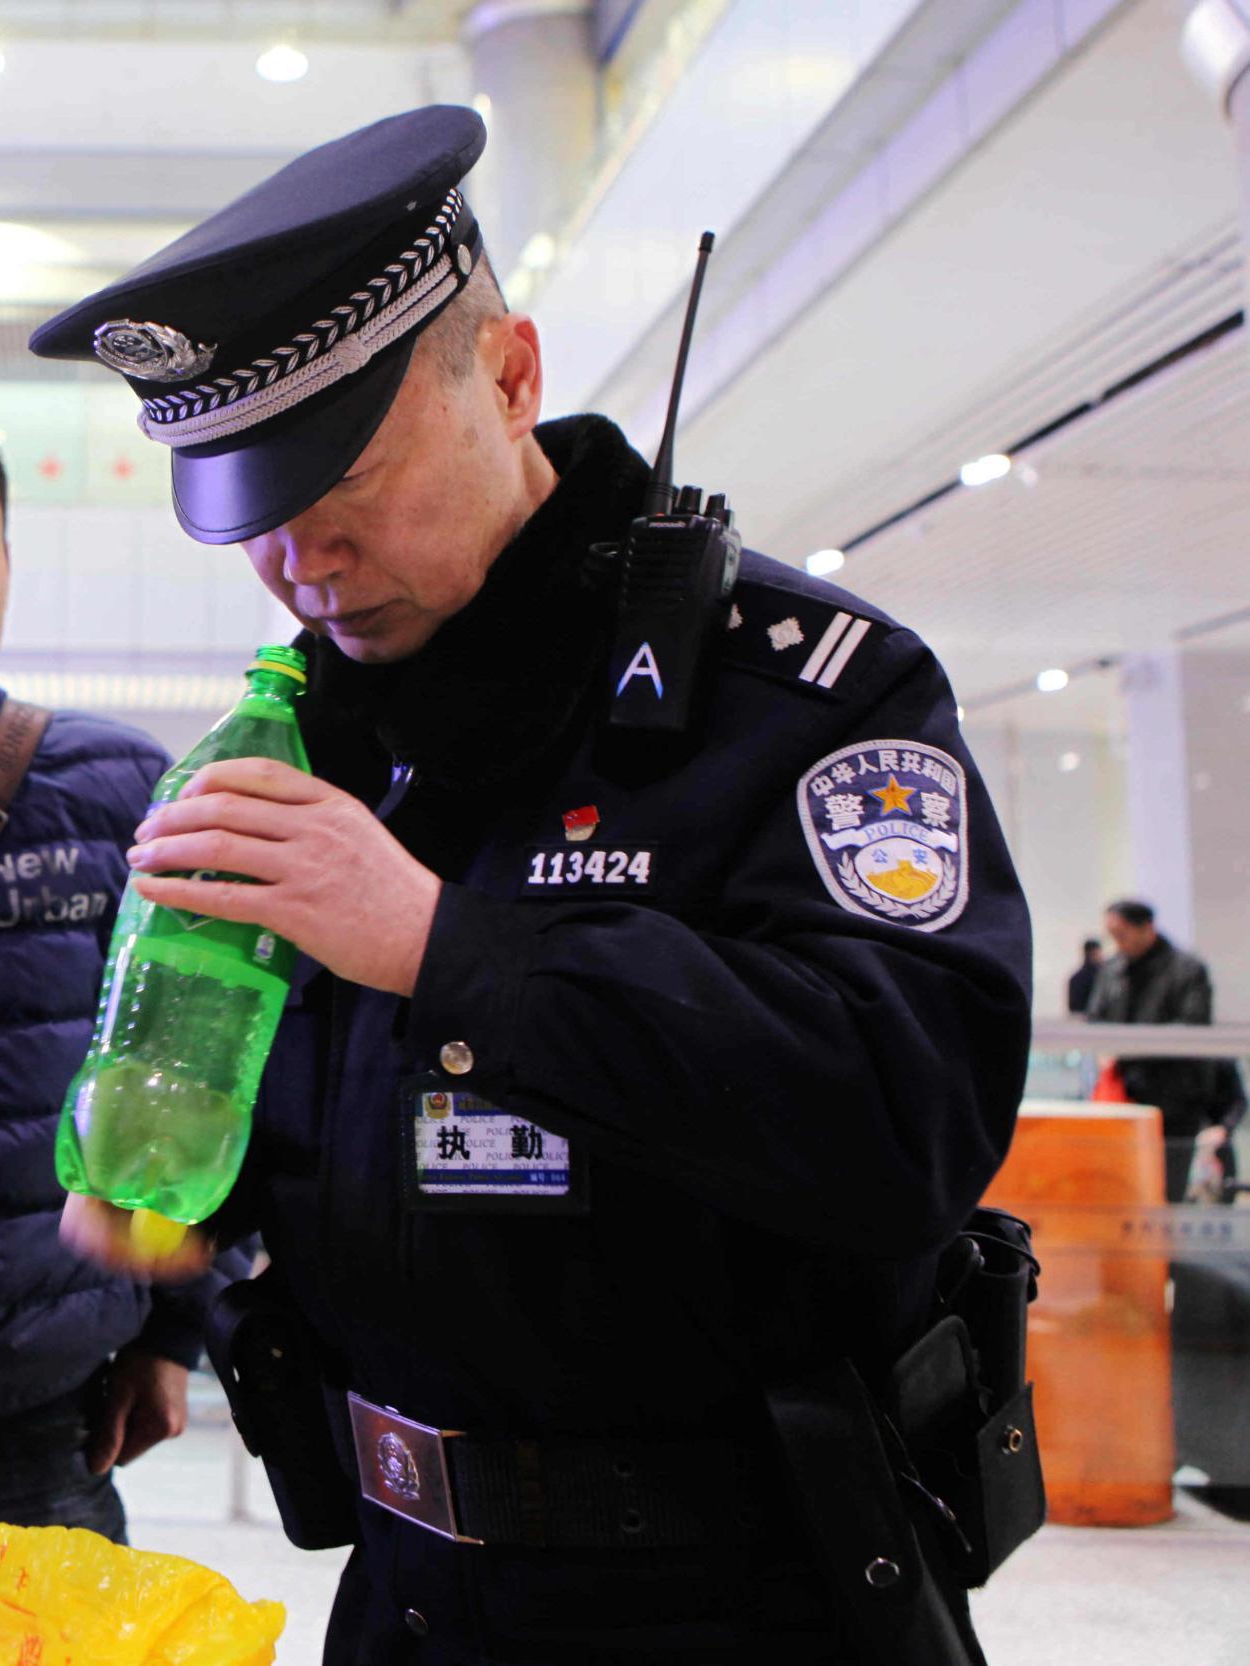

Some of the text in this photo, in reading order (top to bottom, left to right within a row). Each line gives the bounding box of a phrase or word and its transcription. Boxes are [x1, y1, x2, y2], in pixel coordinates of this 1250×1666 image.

[615, 641, 664, 700] A
[810, 749, 958, 797] 中华人民共和国
[863, 824, 929, 842] POLICE
[527, 851, 651, 884] 113424
[436, 1125, 543, 1160] 执勤
